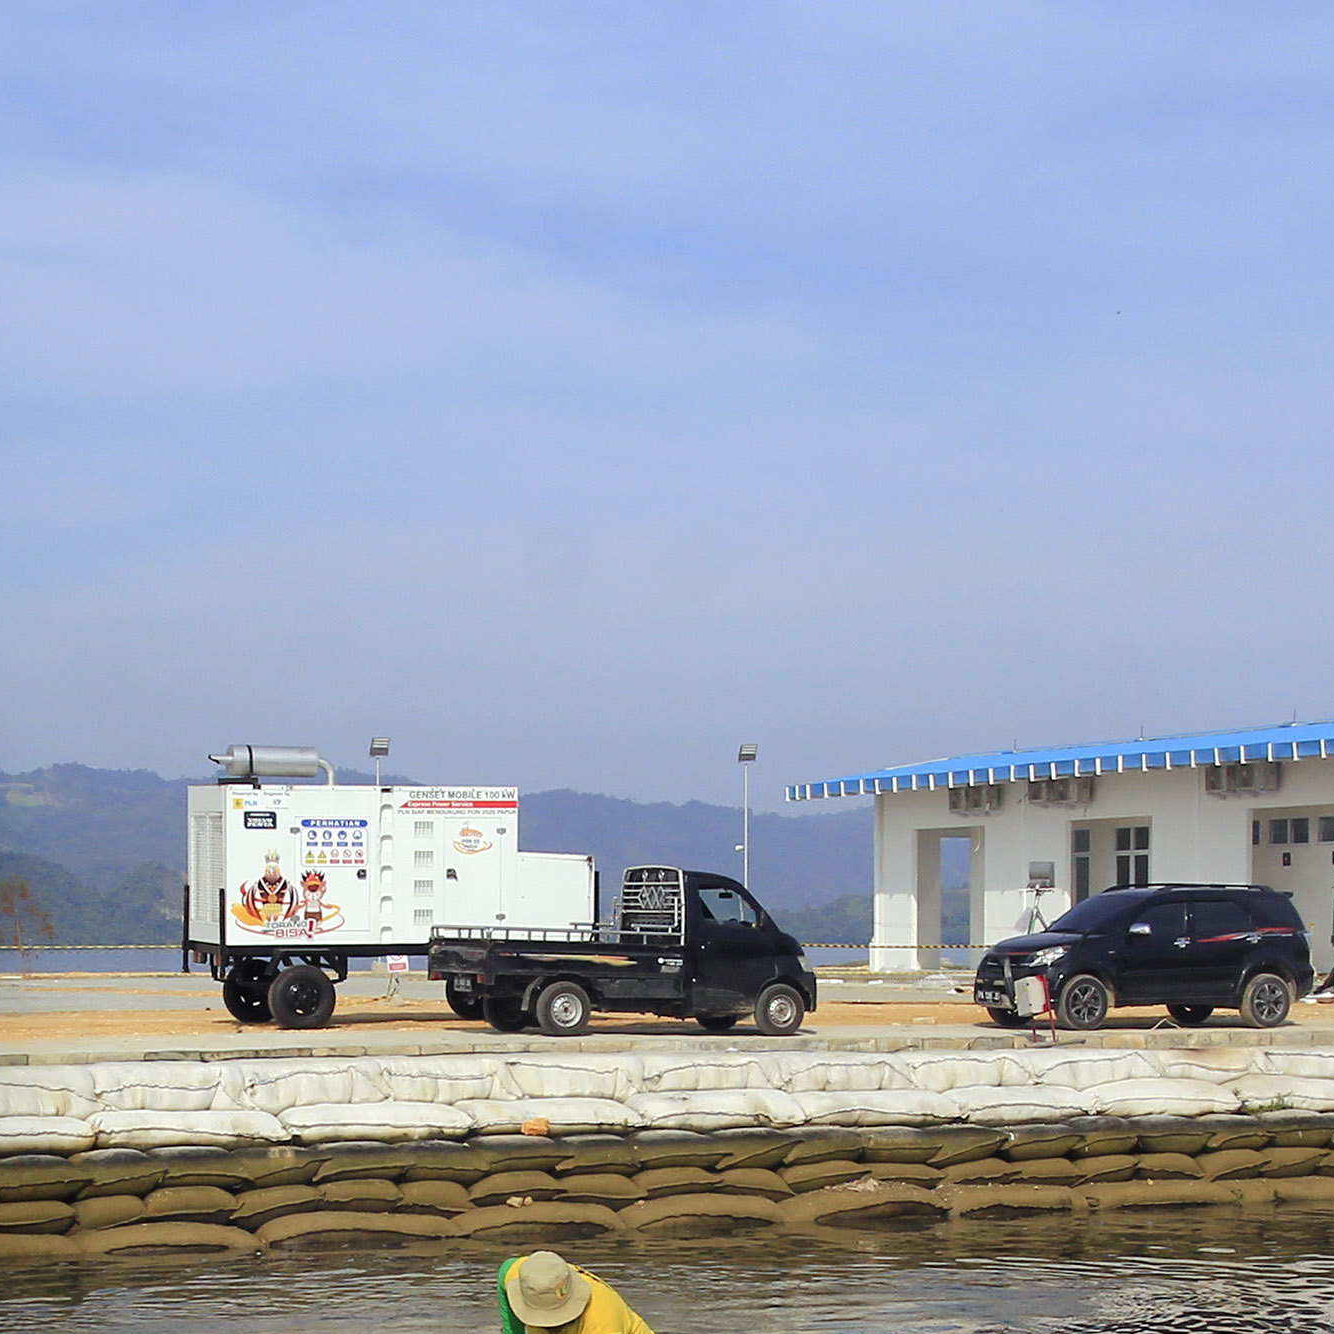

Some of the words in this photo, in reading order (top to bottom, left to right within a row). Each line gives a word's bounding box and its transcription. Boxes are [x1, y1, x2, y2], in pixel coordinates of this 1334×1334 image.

[409, 791, 446, 799] GENSET
[447, 791, 482, 799] MOBILE
[485, 791, 500, 799] 100
[501, 791, 516, 799] kW
